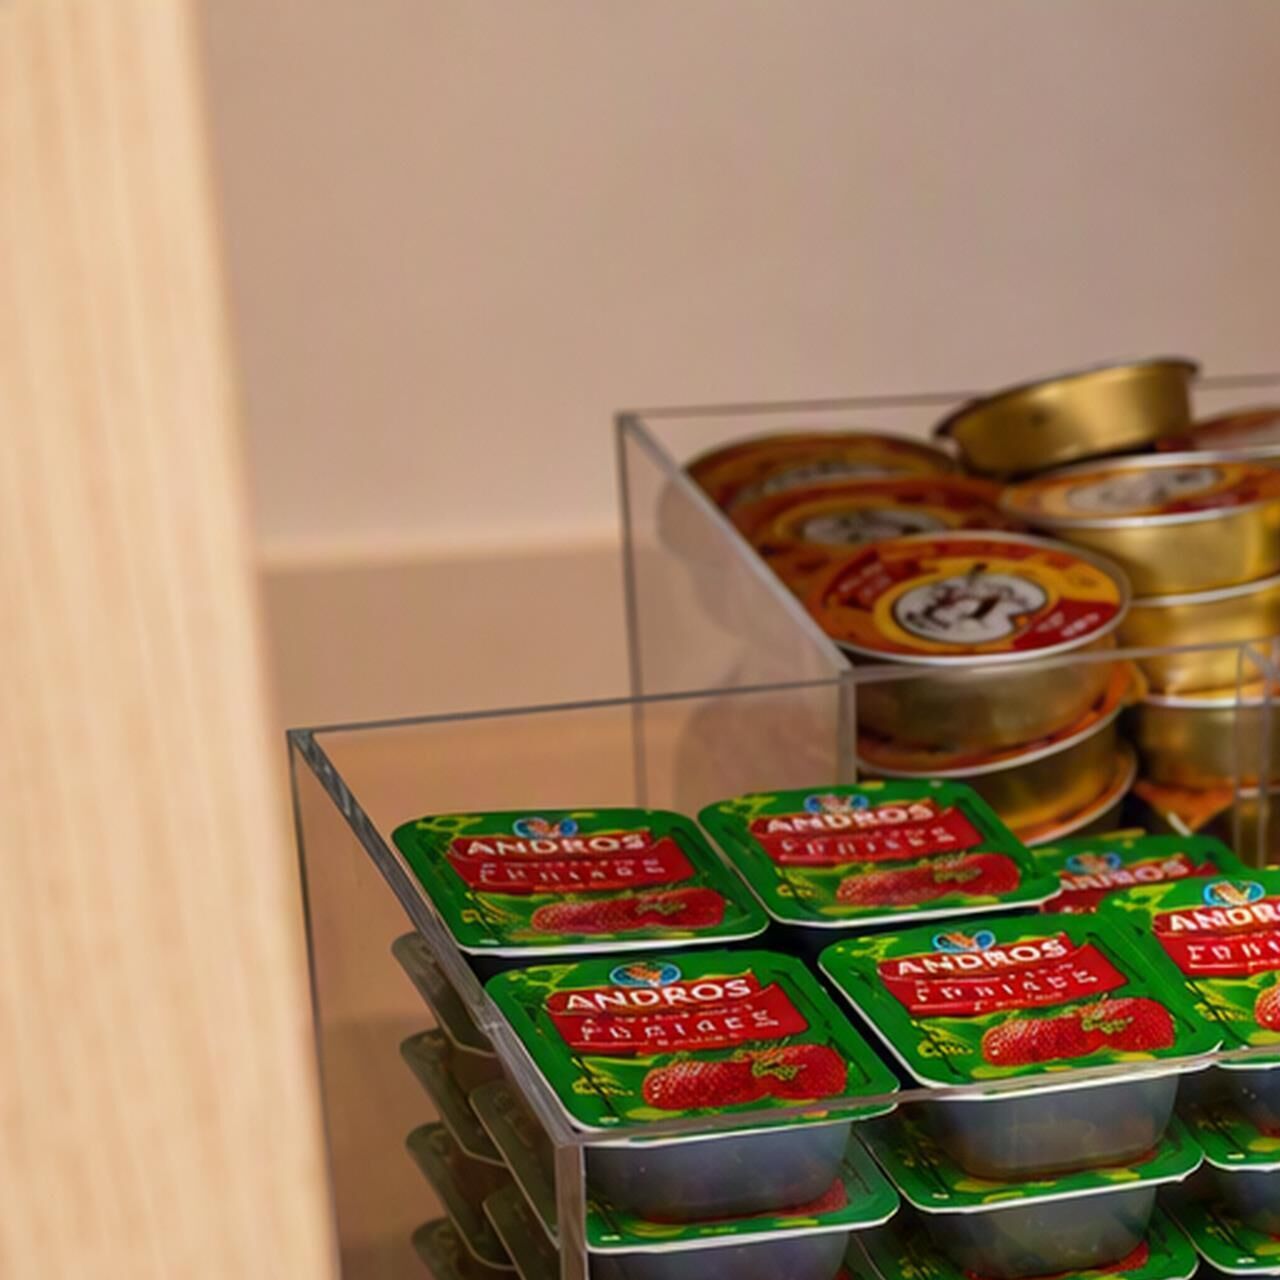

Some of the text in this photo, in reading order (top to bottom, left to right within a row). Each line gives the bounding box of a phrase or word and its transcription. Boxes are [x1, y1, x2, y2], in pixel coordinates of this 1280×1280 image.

[768, 804, 934, 832] ANDROS
[467, 833, 645, 856] ANDROS
[898, 939, 1069, 976] ANDROS
[567, 979, 751, 1010] ANDROS
